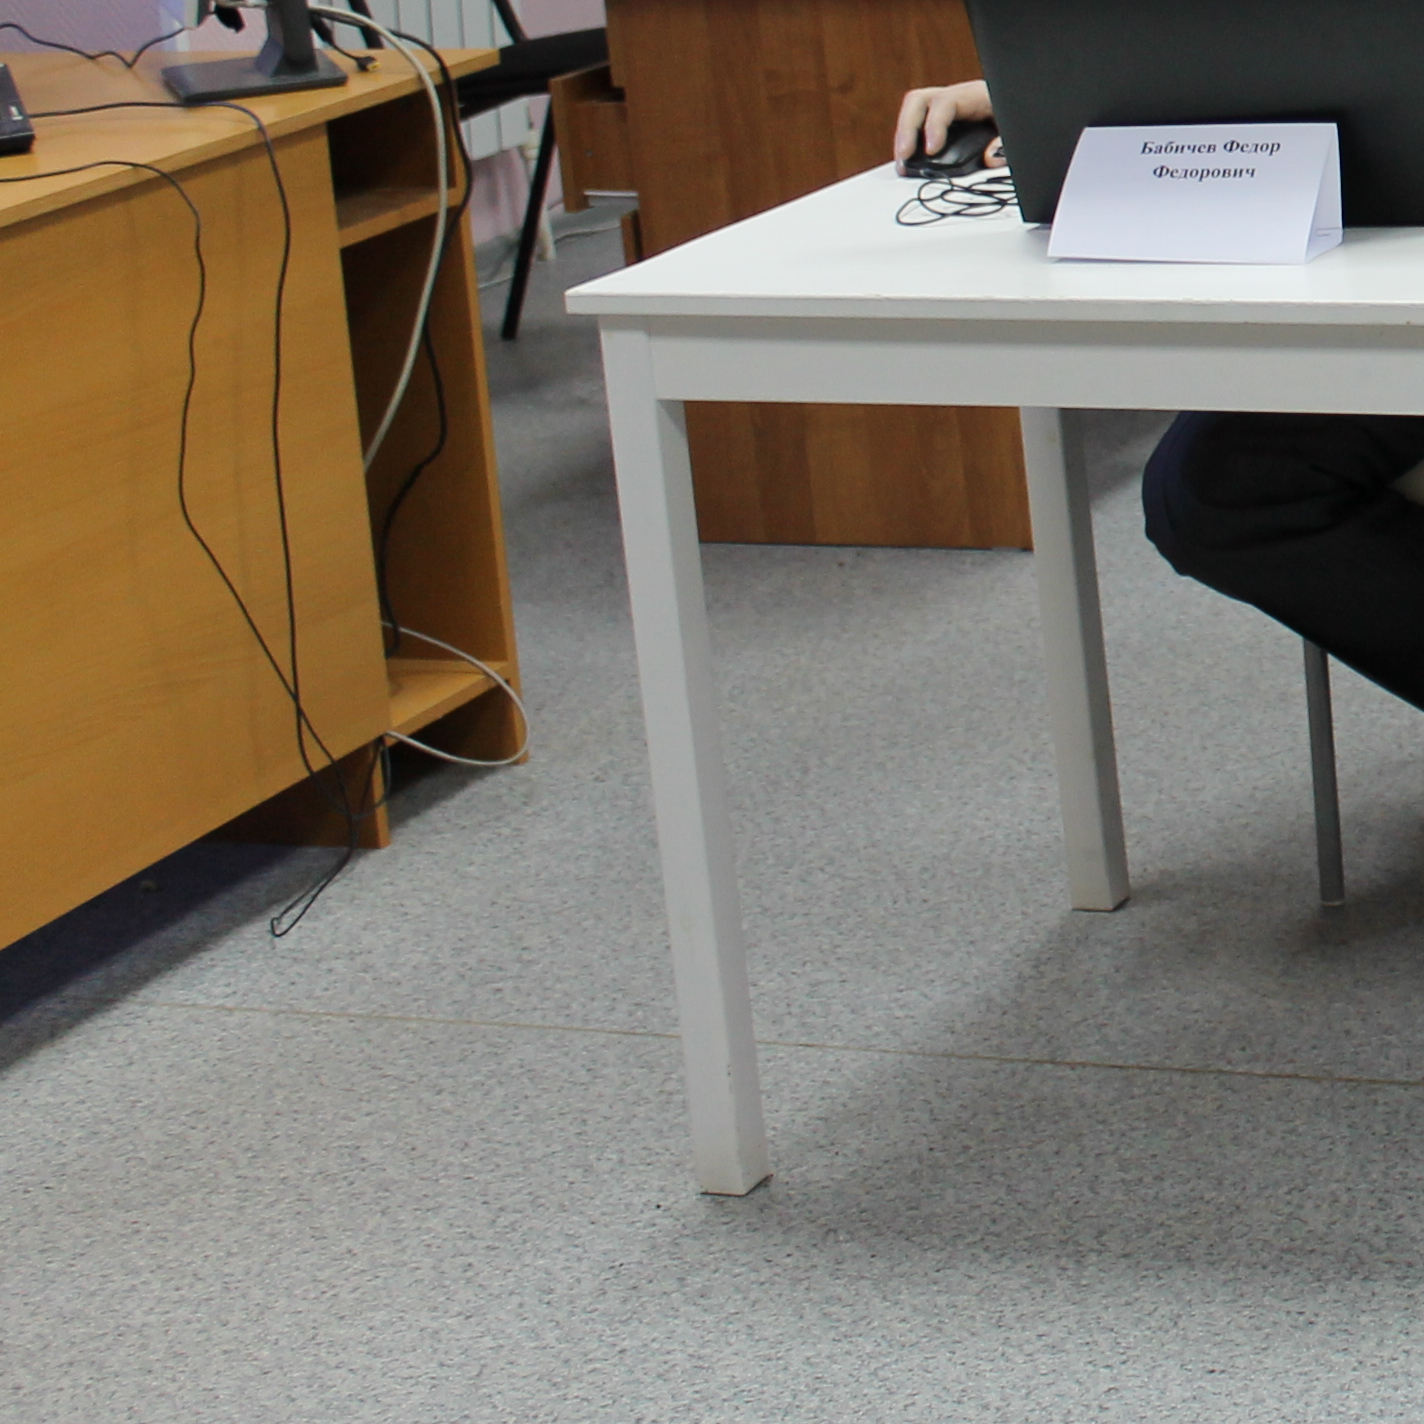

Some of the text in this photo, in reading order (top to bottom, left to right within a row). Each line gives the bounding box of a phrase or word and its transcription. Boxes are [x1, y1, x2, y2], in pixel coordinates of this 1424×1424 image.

[1140, 139, 1281, 156] Бабичев Федор
[1152, 165, 1256, 182] Федорович
